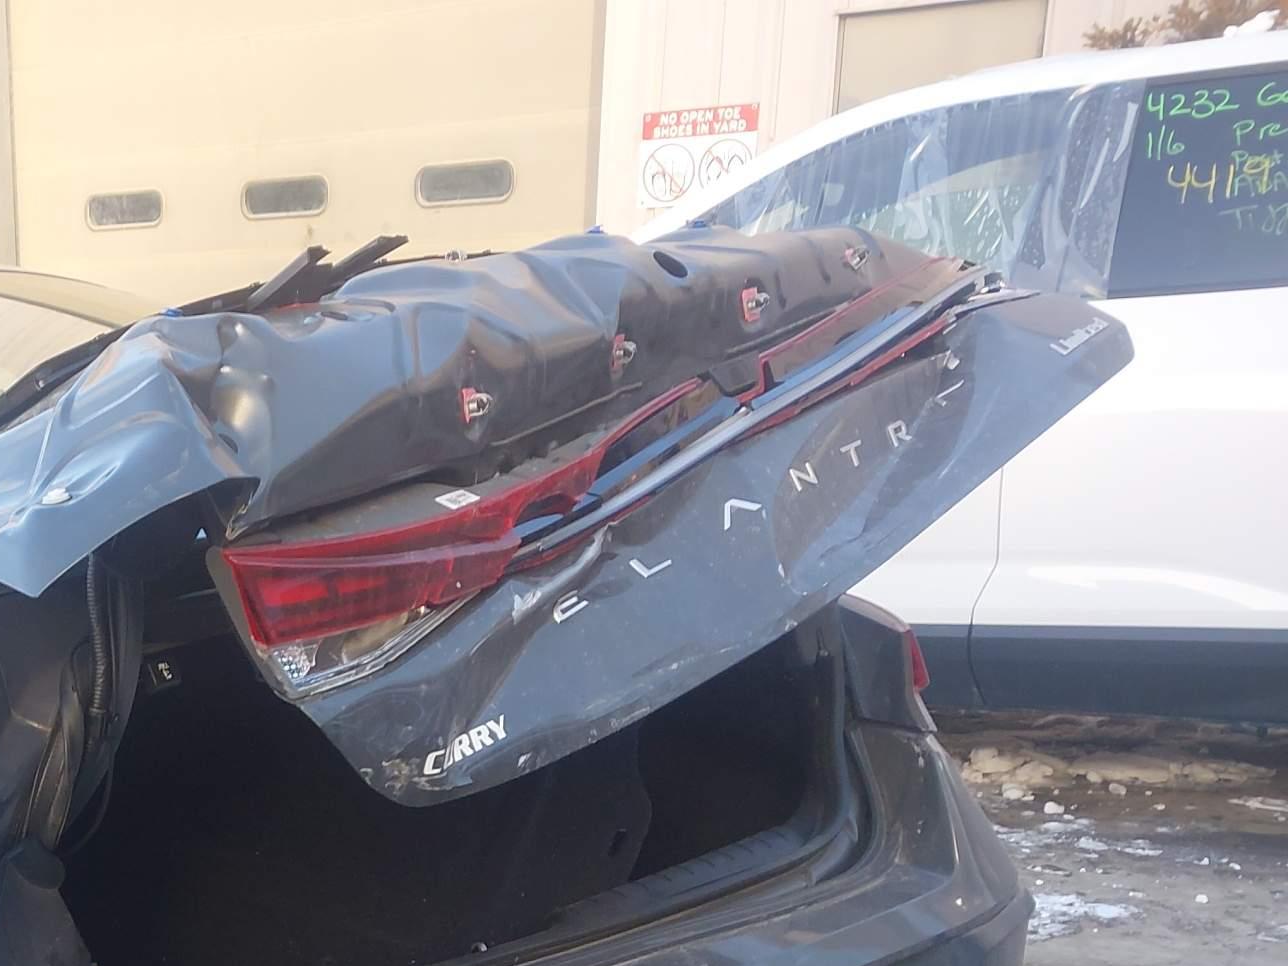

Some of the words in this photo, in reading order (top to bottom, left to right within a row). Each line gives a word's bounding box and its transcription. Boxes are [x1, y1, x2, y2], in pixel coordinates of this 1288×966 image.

[660, 112, 677, 126] NO
[680, 108, 714, 124] OPEN
[718, 106, 742, 120] TOE
[1147, 89, 1240, 121] 4232
[697, 122, 710, 136] IN
[713, 119, 747, 134] YARD
[1167, 153, 1270, 204] 4419
